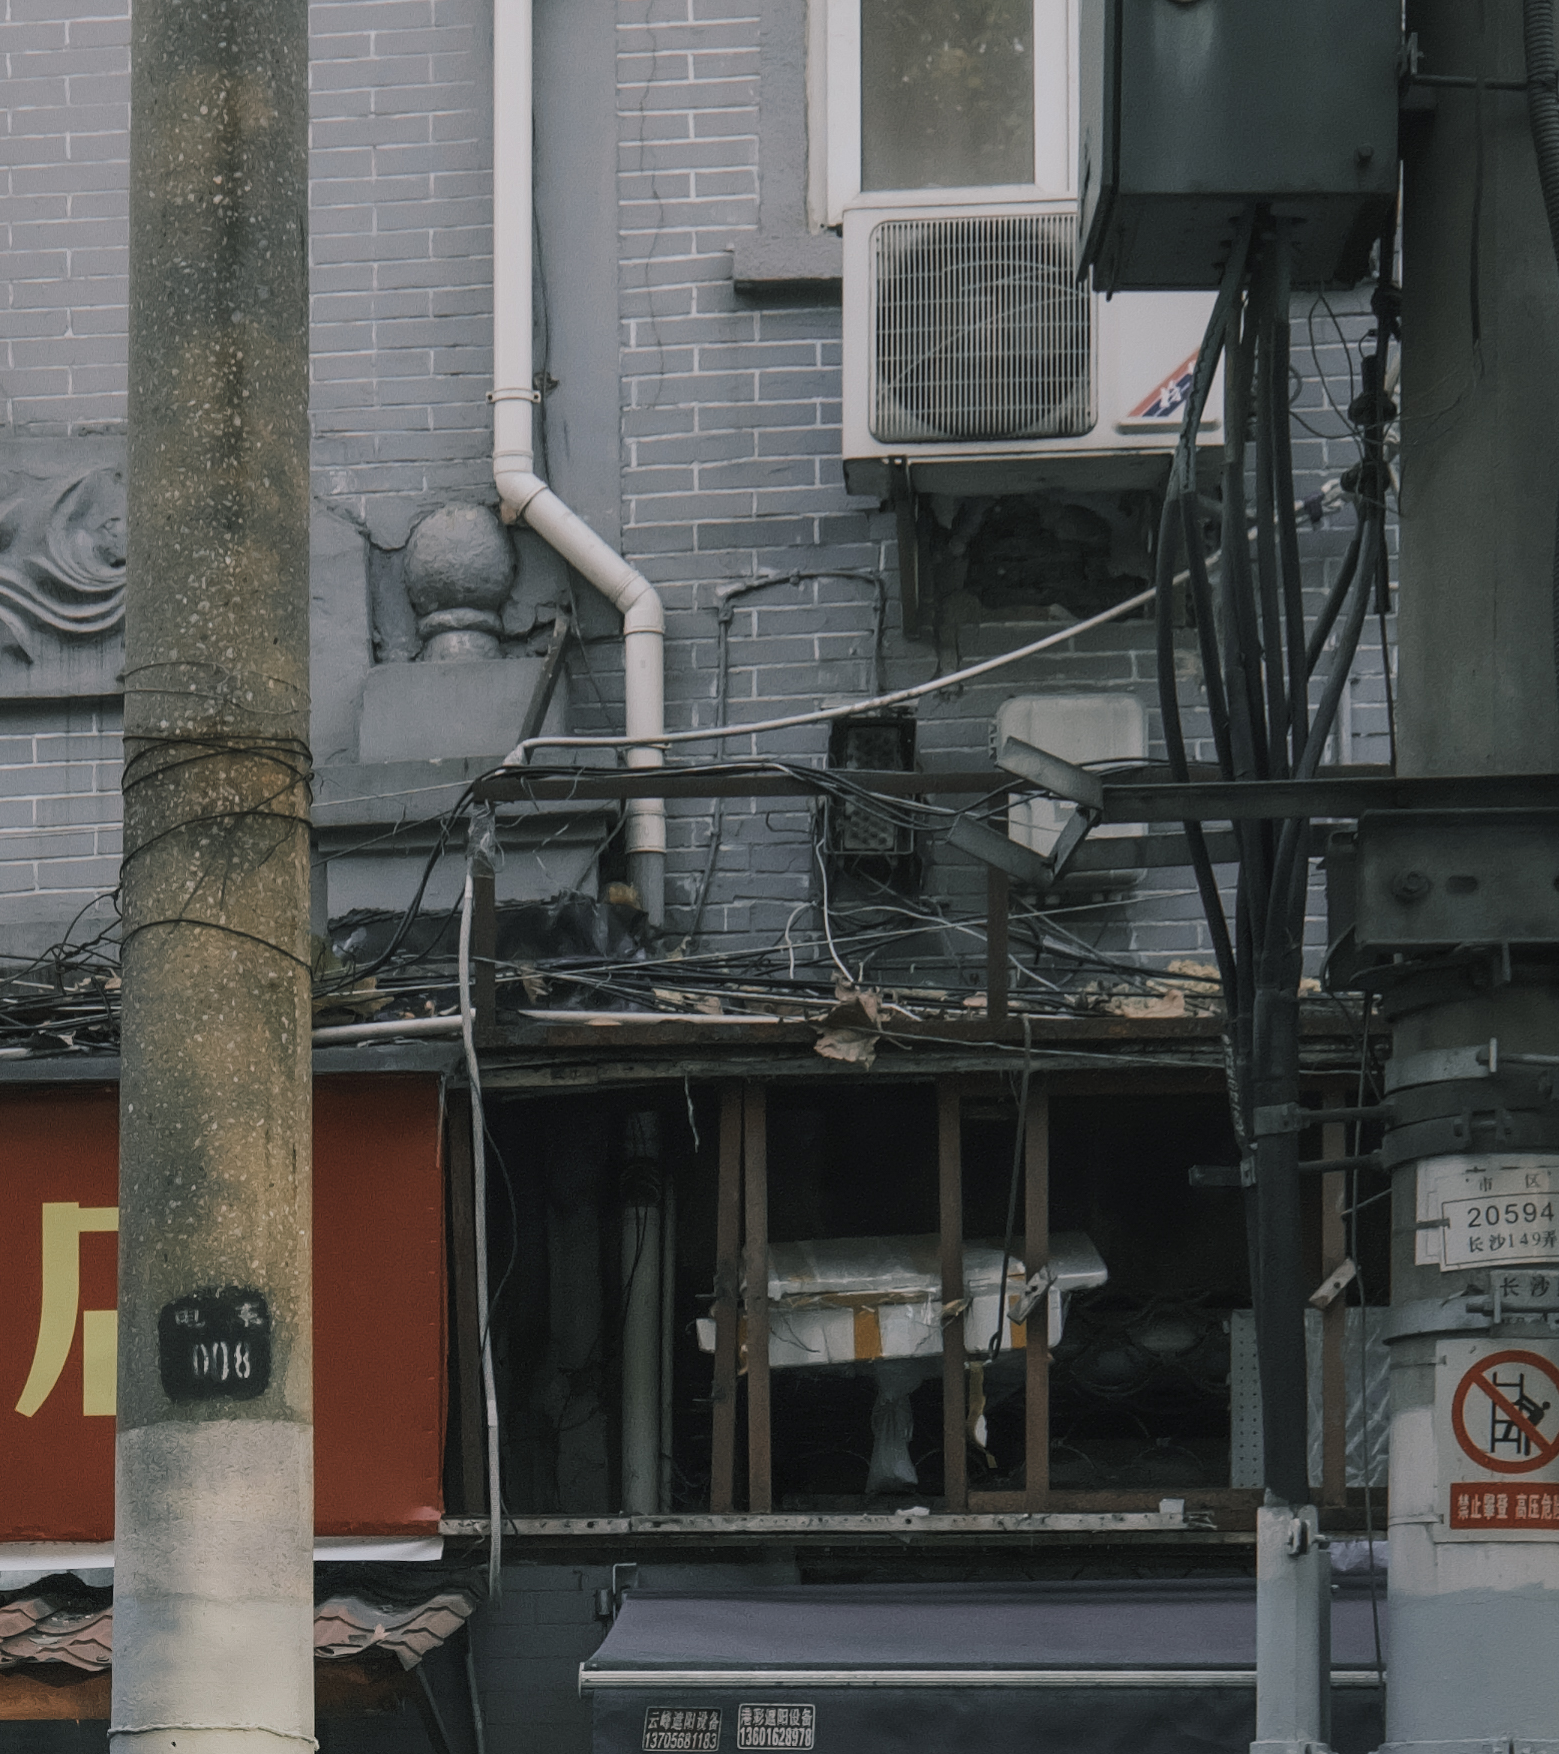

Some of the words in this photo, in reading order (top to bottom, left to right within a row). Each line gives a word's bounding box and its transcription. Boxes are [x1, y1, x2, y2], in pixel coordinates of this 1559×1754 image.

[1479, 1172, 1542, 1193] 市区
[1467, 1201, 1555, 1229] 20594
[1467, 1228, 1558, 1254] 长沙149弄
[1457, 1495, 1509, 1521] 禁止攀登
[739, 1726, 813, 1747] 13601628978
